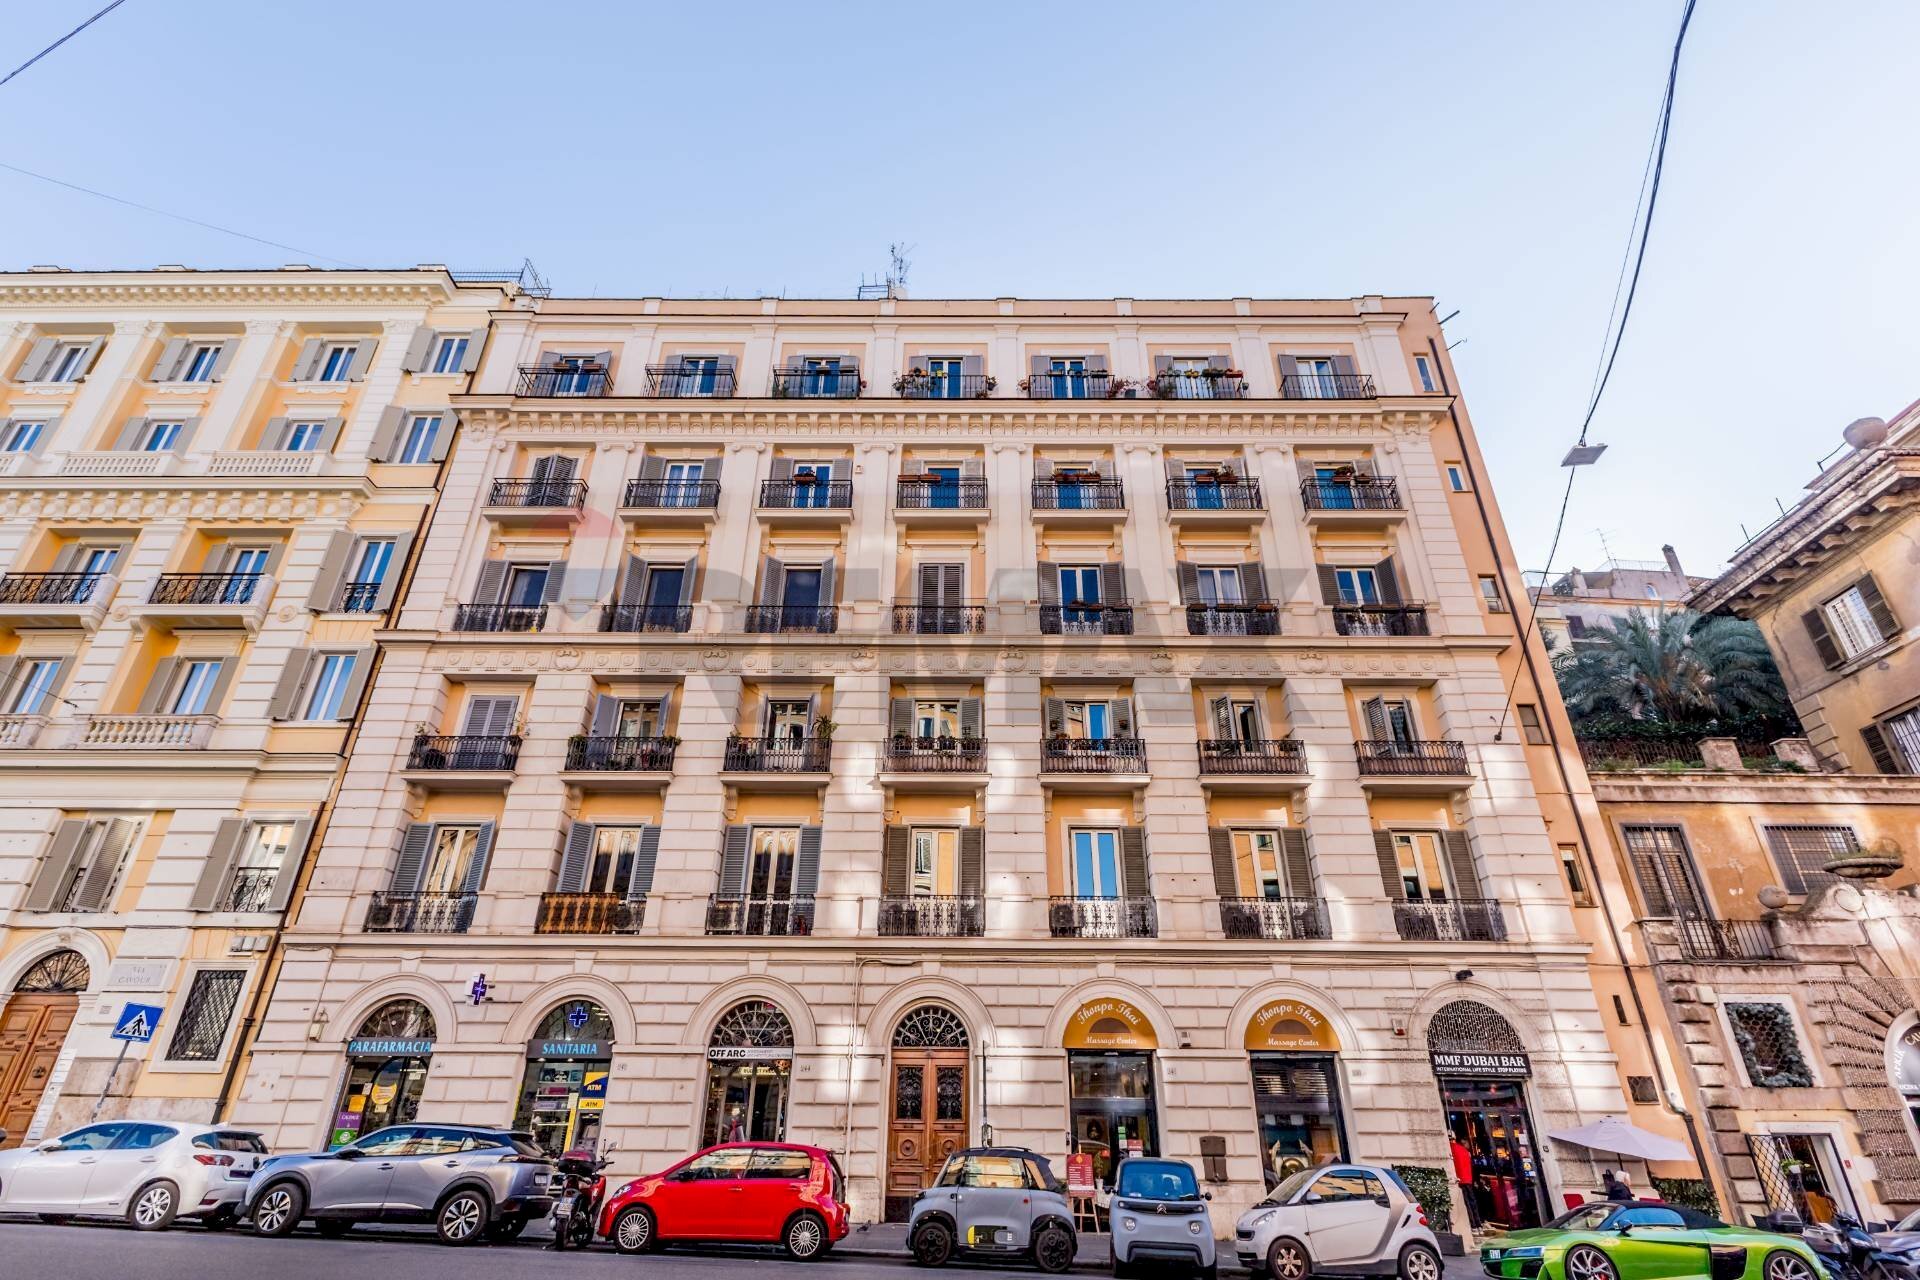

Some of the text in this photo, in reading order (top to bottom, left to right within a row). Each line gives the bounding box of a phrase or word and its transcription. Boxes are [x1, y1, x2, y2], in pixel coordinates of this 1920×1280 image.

[1116, 1003, 1141, 1025] Thai
[1295, 1004, 1322, 1027] Thai
[348, 1040, 432, 1053] PARAFARMACIA
[1086, 1036, 1116, 1045] Massage
[1266, 1037, 1320, 1047] Massage Center
[542, 1042, 598, 1055] SANITARIA
[709, 1049, 727, 1058] OFF
[727, 1049, 746, 1058] ARC
[1434, 1054, 1526, 1067] MMF DUBAI BAR
[585, 1100, 599, 1108] ATM
